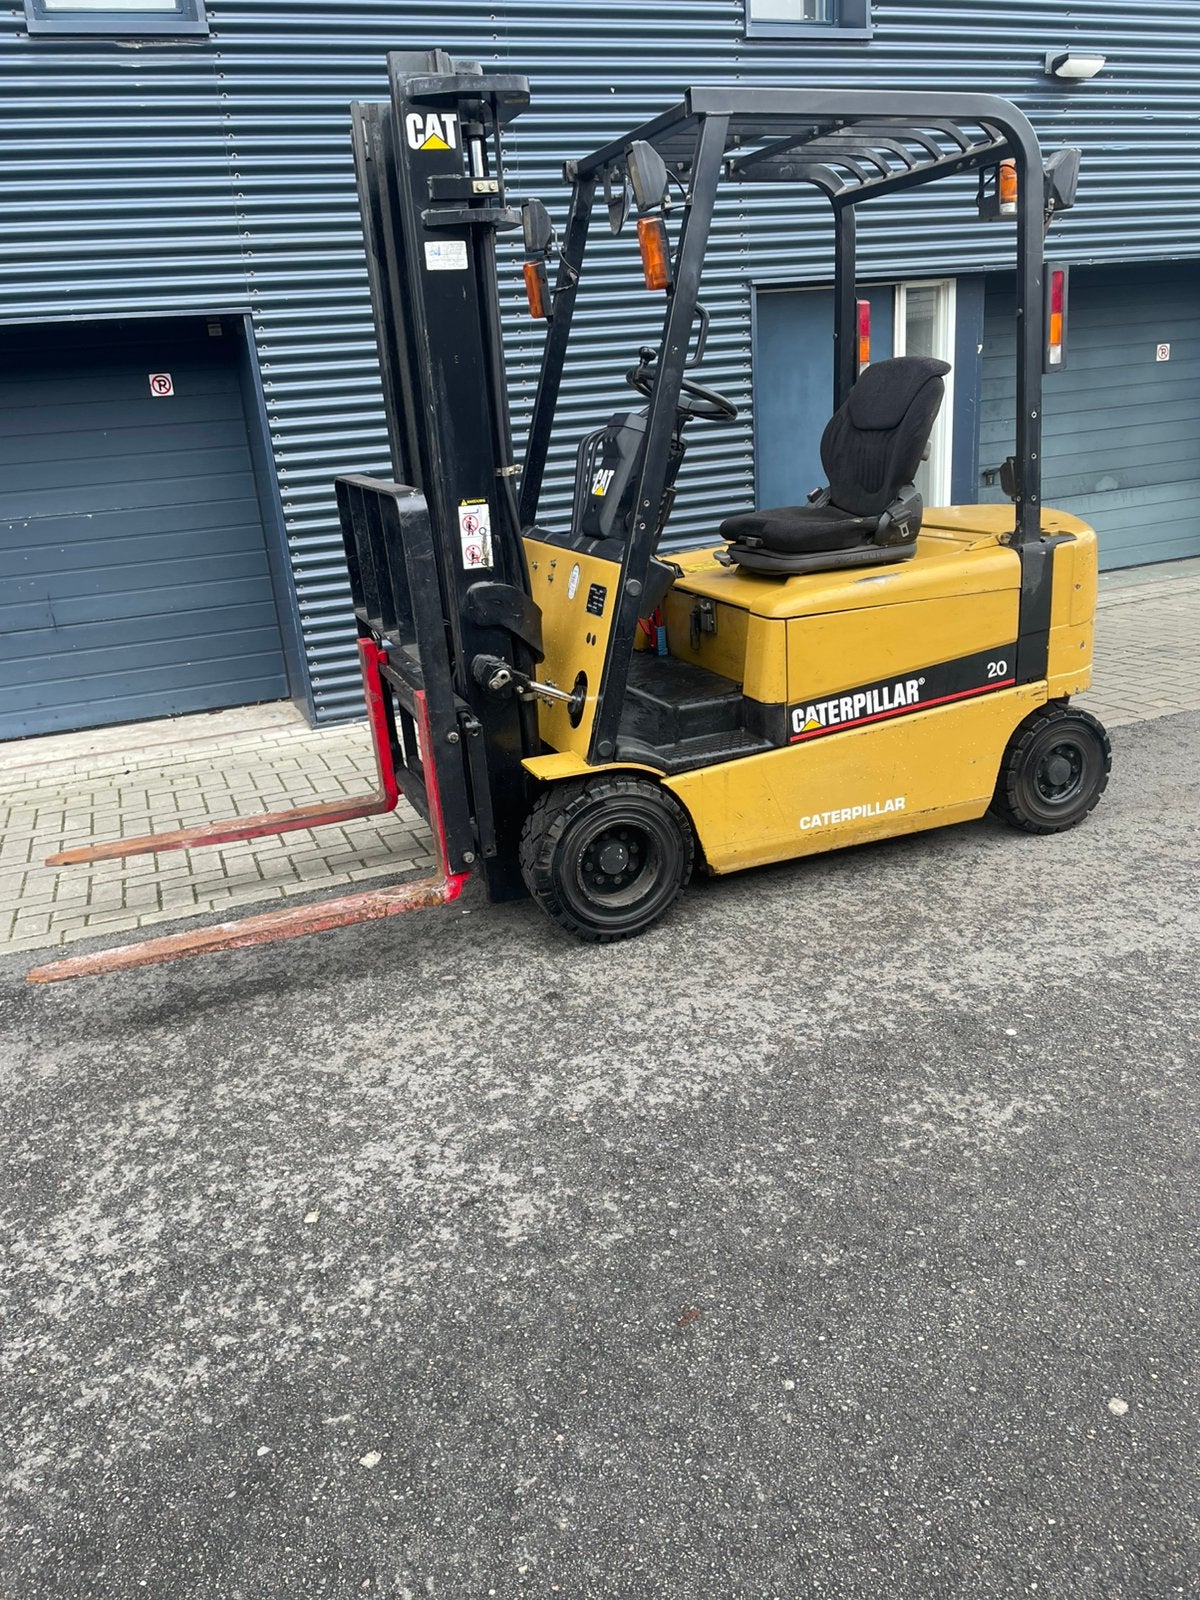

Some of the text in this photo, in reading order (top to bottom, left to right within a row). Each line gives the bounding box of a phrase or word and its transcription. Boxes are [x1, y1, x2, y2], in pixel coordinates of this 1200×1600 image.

[405, 112, 458, 150] CAT
[591, 468, 616, 497] CAT
[987, 660, 1008, 678] 20
[799, 796, 906, 830] CATERPILLAR
